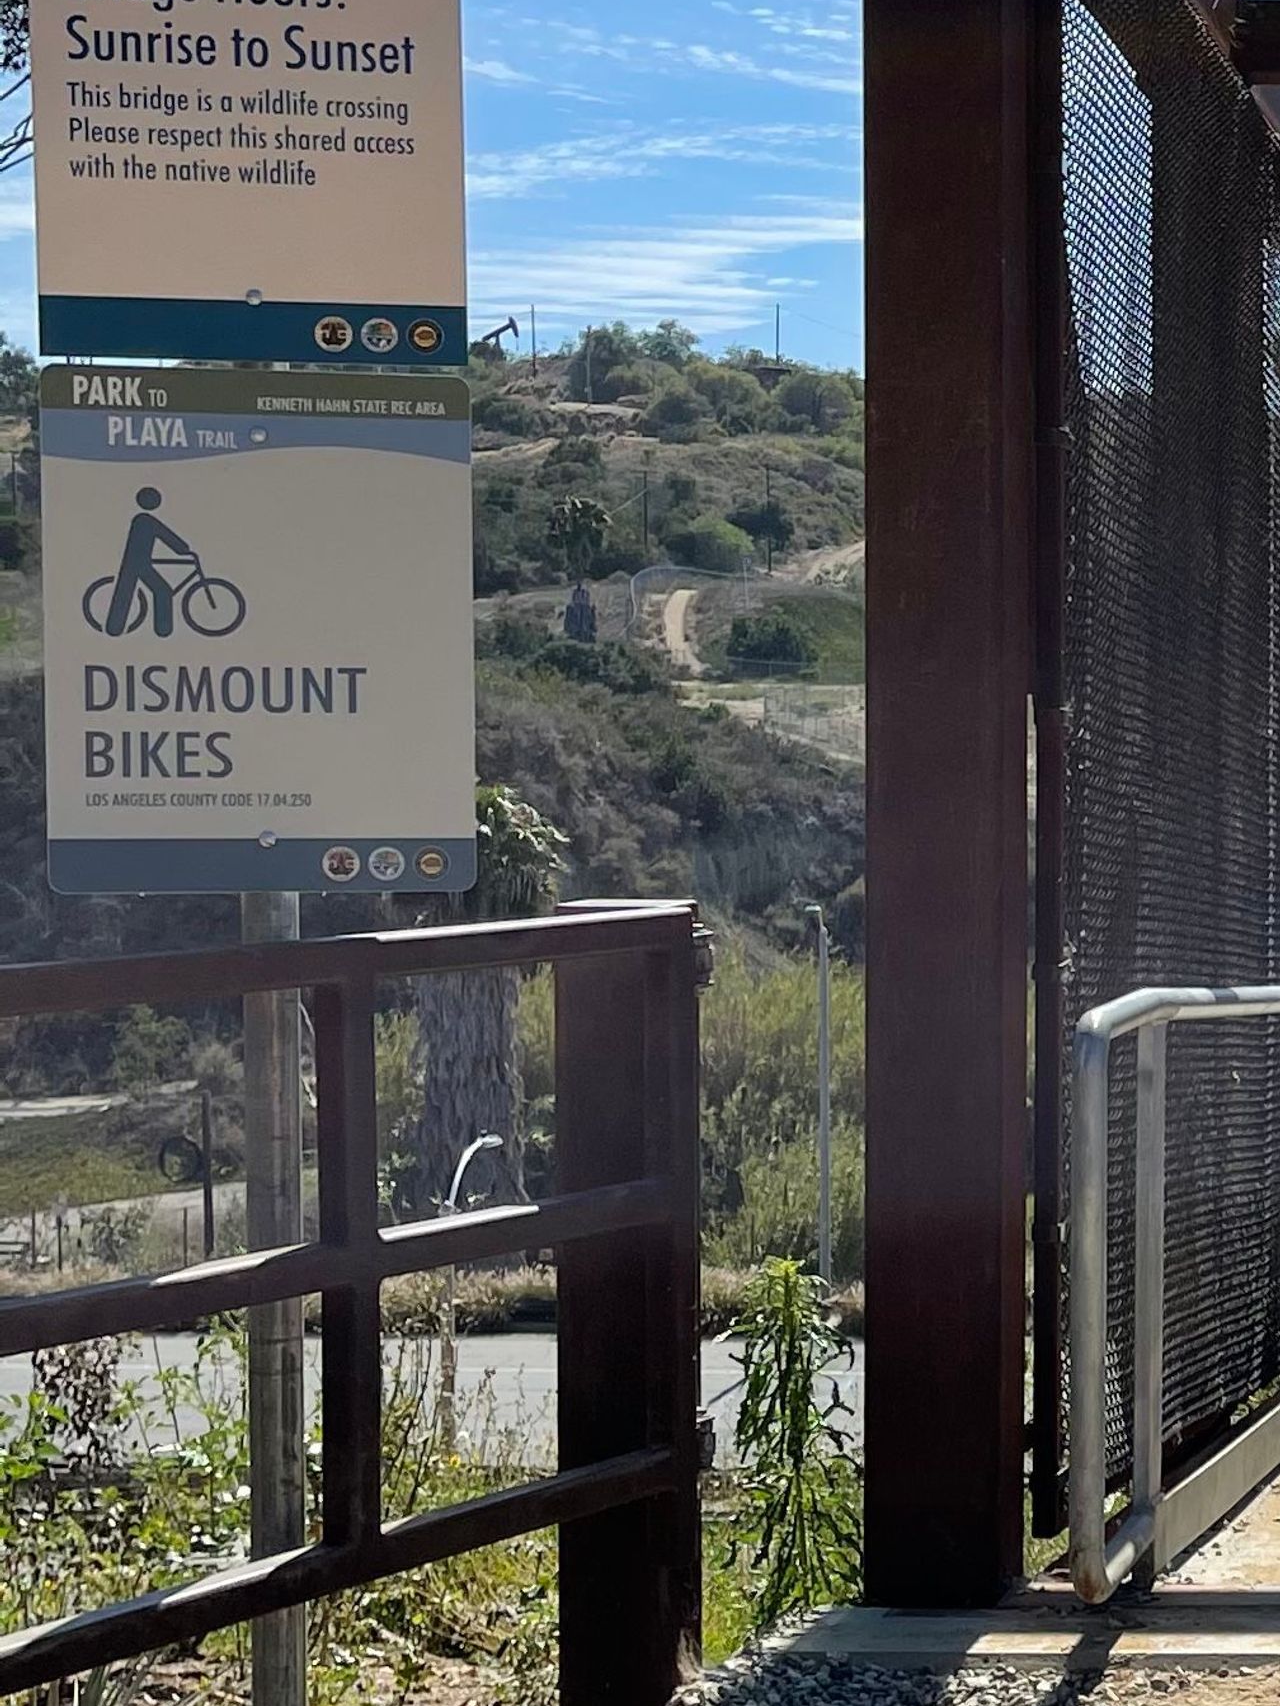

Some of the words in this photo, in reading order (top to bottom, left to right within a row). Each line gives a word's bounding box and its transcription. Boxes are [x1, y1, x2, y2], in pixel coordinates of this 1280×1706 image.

[67, 15, 217, 66] Sunrise
[231, 27, 269, 68] to
[285, 25, 415, 74] Sunset
[67, 82, 111, 109] This
[119, 85, 189, 114] bridge
[197, 88, 212, 112] is
[221, 96, 233, 113] a
[240, 90, 319, 117] wildlife
[326, 96, 409, 125] crossing
[69, 118, 140, 145] Please
[148, 125, 222, 150] respect
[230, 124, 268, 150] this
[274, 125, 346, 152] shared
[354, 137, 415, 155] access
[69, 154, 115, 179] with
[124, 157, 157, 180] the
[165, 158, 231, 183] native
[239, 160, 316, 186] wildlife
[73, 376, 142, 406] PARK
[149, 389, 167, 407] TO
[257, 396, 312, 413] KENNETH
[316, 398, 351, 413] HAHN
[353, 399, 388, 414] STATE
[391, 400, 413, 415] REC
[416, 401, 446, 416] AREA
[108, 417, 188, 447] PLAYA
[197, 431, 238, 449] TRAIL
[84, 665, 367, 713] DISMOUNT
[85, 732, 233, 778] BIKES
[86, 793, 109, 806] LOS
[112, 793, 166, 806] ANGELES
[170, 793, 218, 806] COUNTY
[221, 793, 253, 807] CODE
